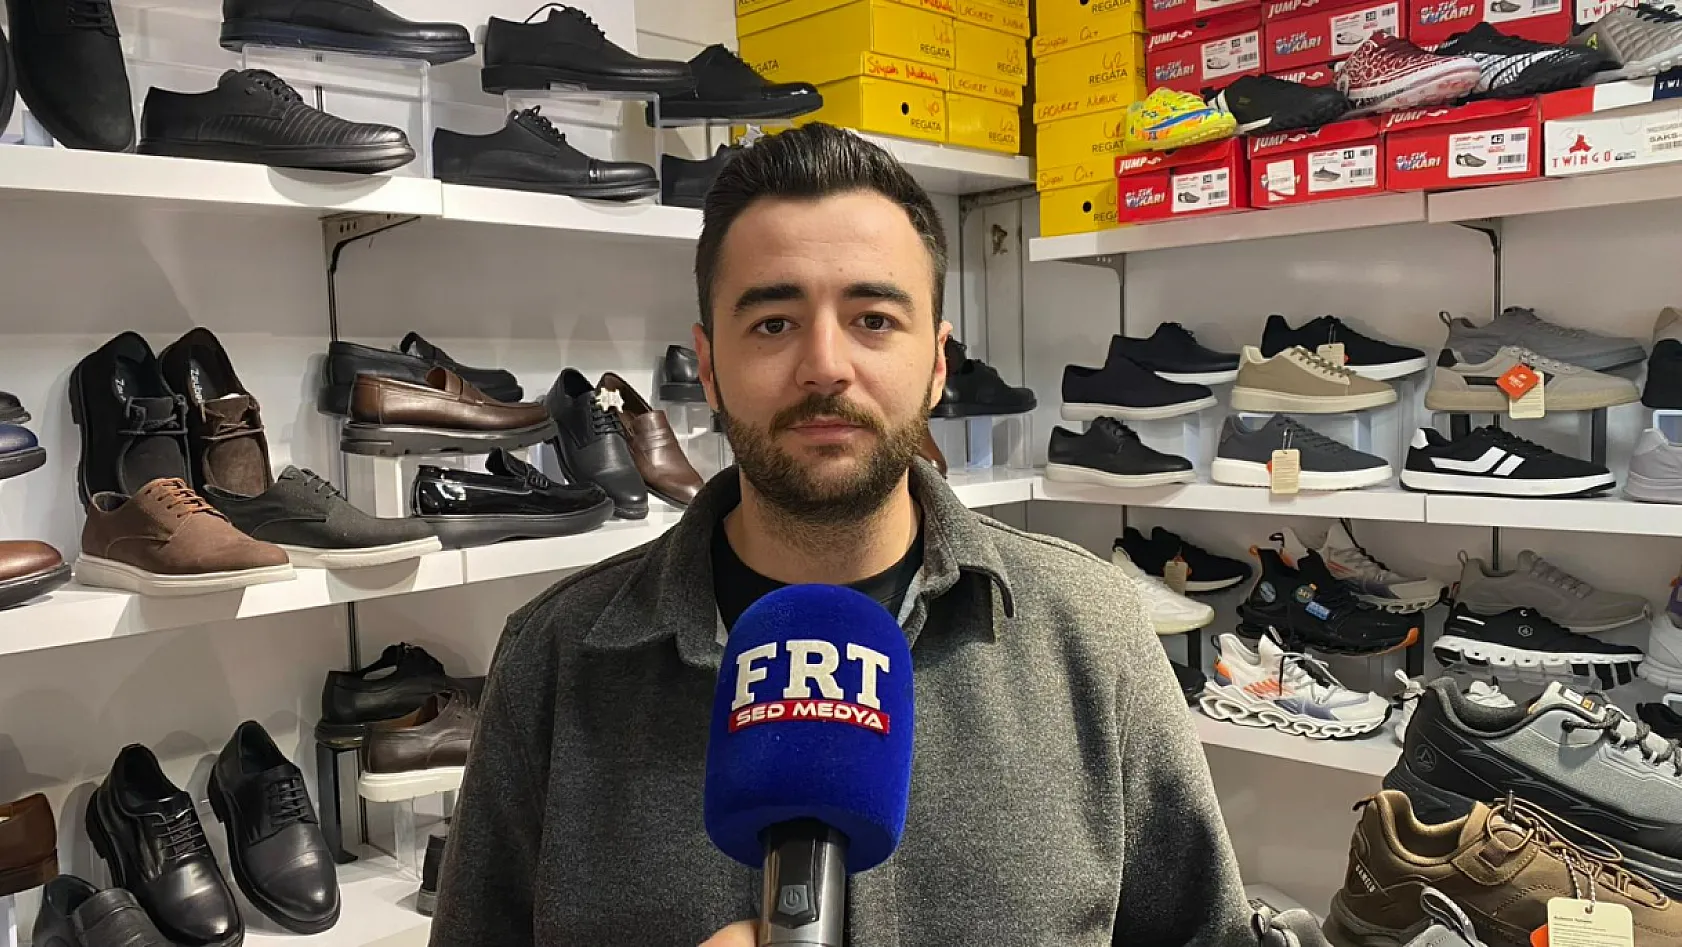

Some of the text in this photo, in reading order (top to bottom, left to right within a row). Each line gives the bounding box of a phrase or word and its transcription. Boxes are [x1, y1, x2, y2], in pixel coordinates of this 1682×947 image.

[1148, 31, 1178, 52] JUMP
[919, 43, 951, 58] REGATA
[1089, 69, 1128, 84] REGATA
[911, 118, 941, 131] REGATA
[1385, 110, 1428, 128] JUMP
[988, 131, 1016, 144] REGATA
[1253, 134, 1288, 152] JUMP
[1092, 140, 1125, 153] REGAT
[1343, 150, 1354, 160] 41
[1119, 156, 1148, 174] JUMP
[1552, 151, 1611, 168] TWINGO
[731, 639, 890, 711] FRT
[736, 702, 884, 730] SED MEDYA
